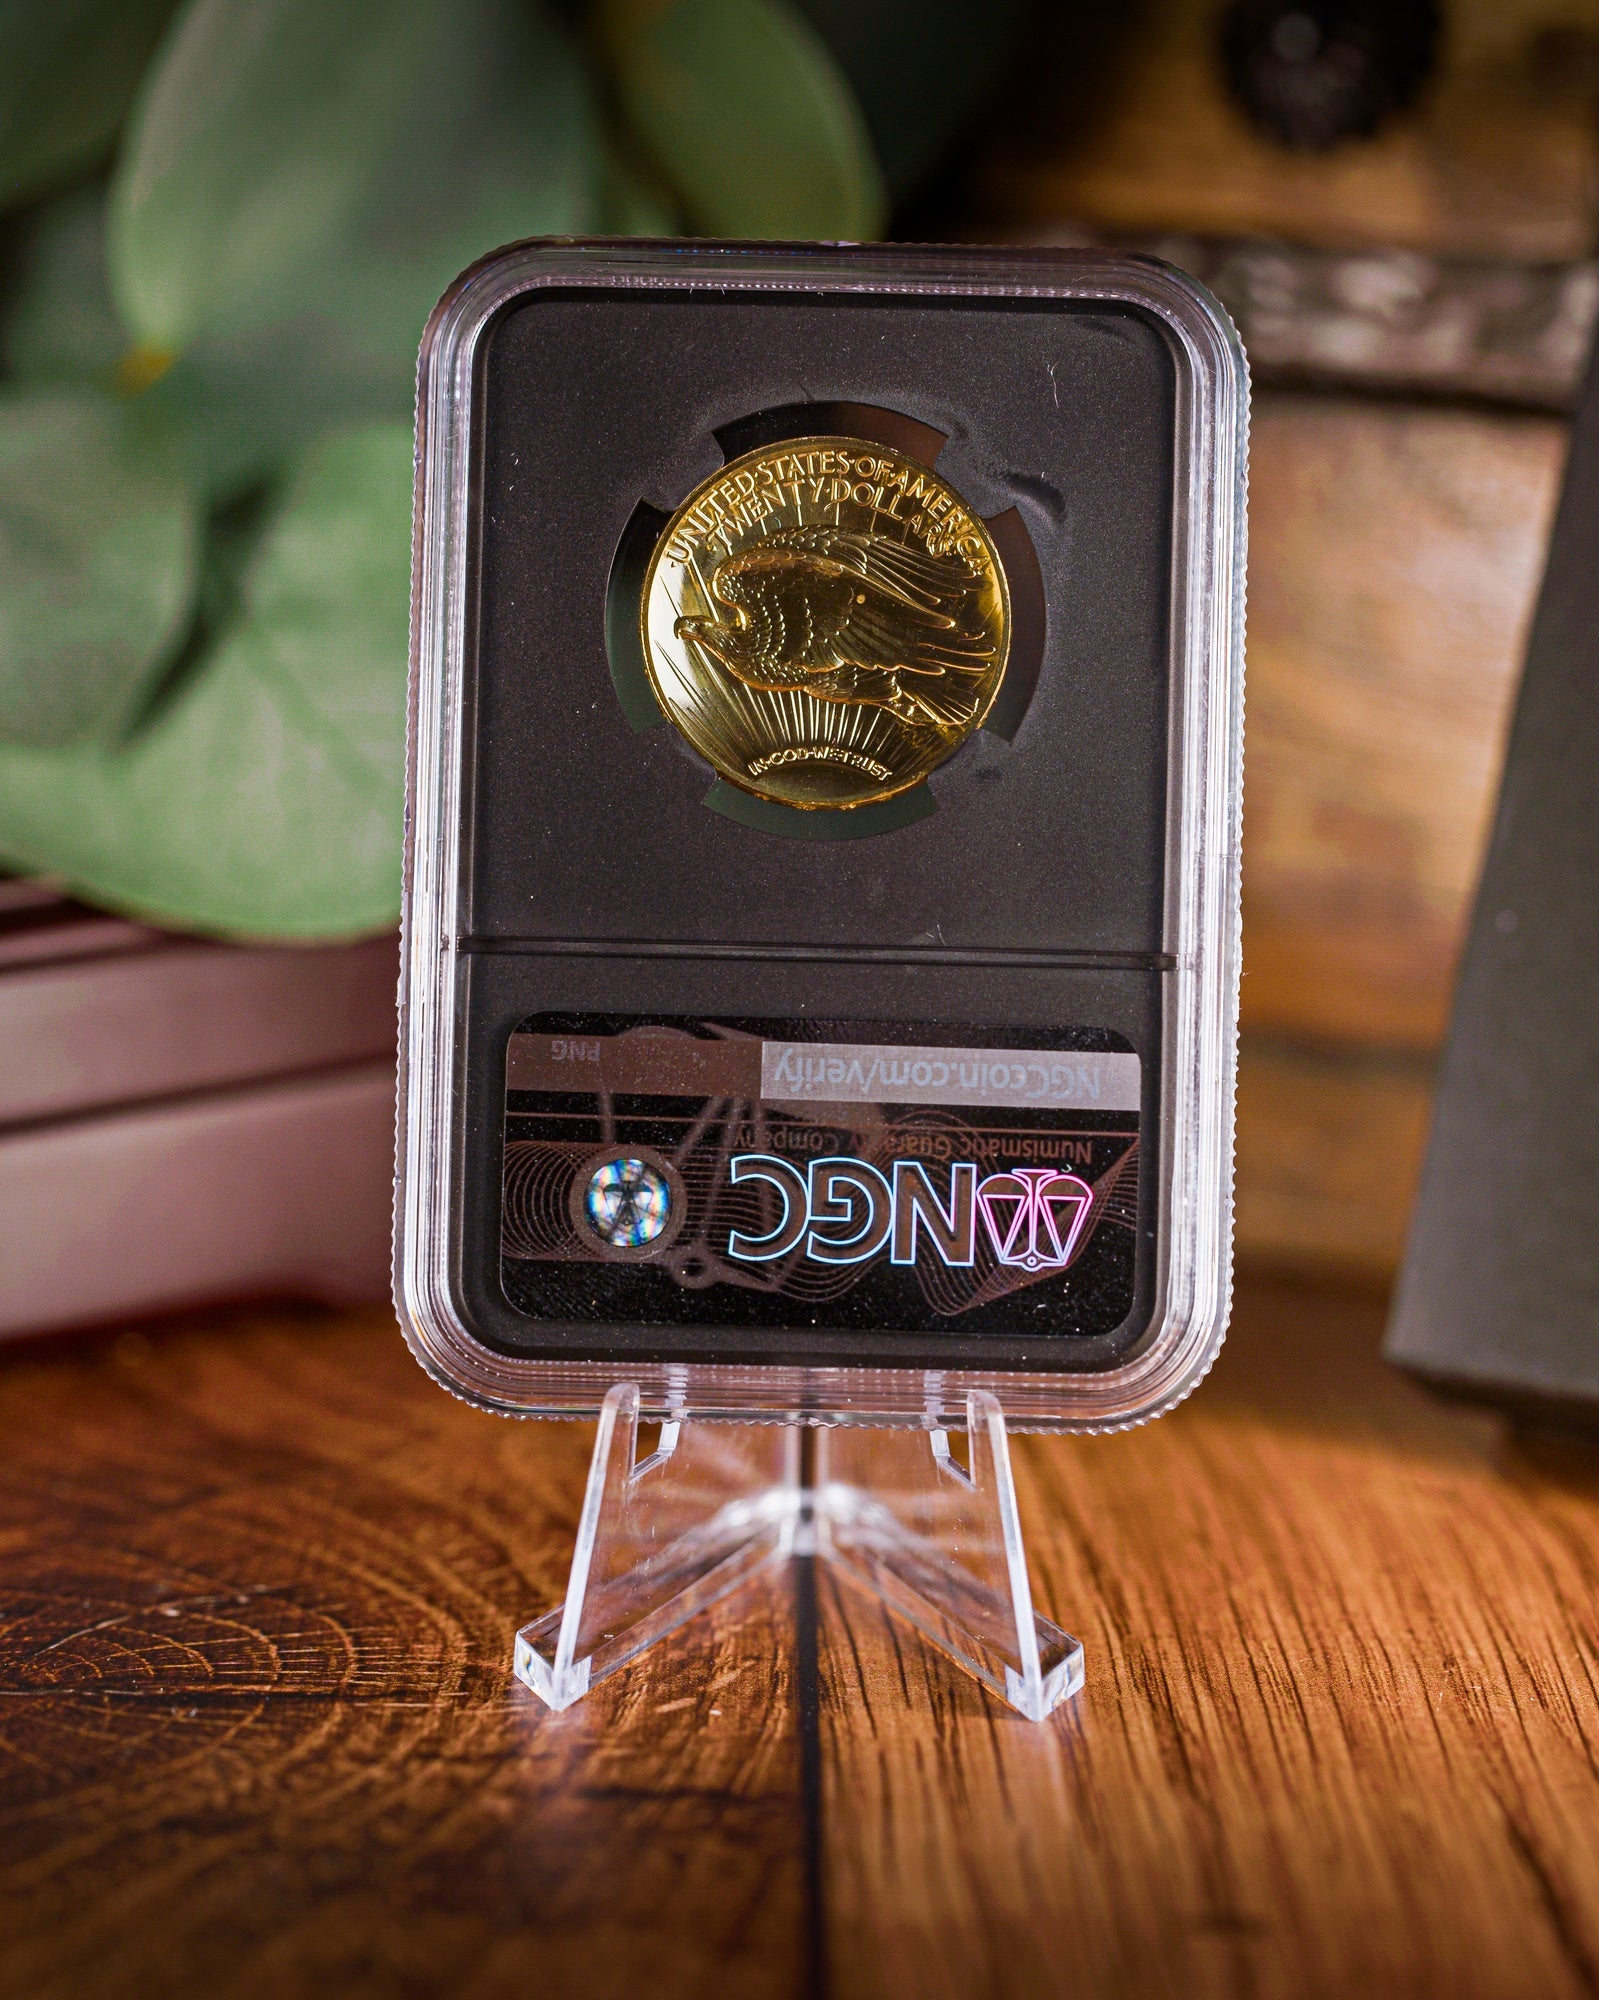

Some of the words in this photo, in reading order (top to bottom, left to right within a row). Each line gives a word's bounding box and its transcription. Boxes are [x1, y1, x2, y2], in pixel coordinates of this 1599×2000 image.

[666, 468, 757, 563] UNITED
[757, 450, 851, 486] STATES
[854, 455, 895, 482] OF
[704, 476, 825, 557] TWENTY
[747, 757, 769, 777] IN
[839, 750, 893, 782] TRUST
[550, 1040, 601, 1062] PNG
[772, 1048, 1100, 1100] NGCcoin.com/verify
[848, 1132, 954, 1160] Guaray
[959, 1137, 1094, 1166] Numismatic
[728, 1154, 977, 1267] NGC
